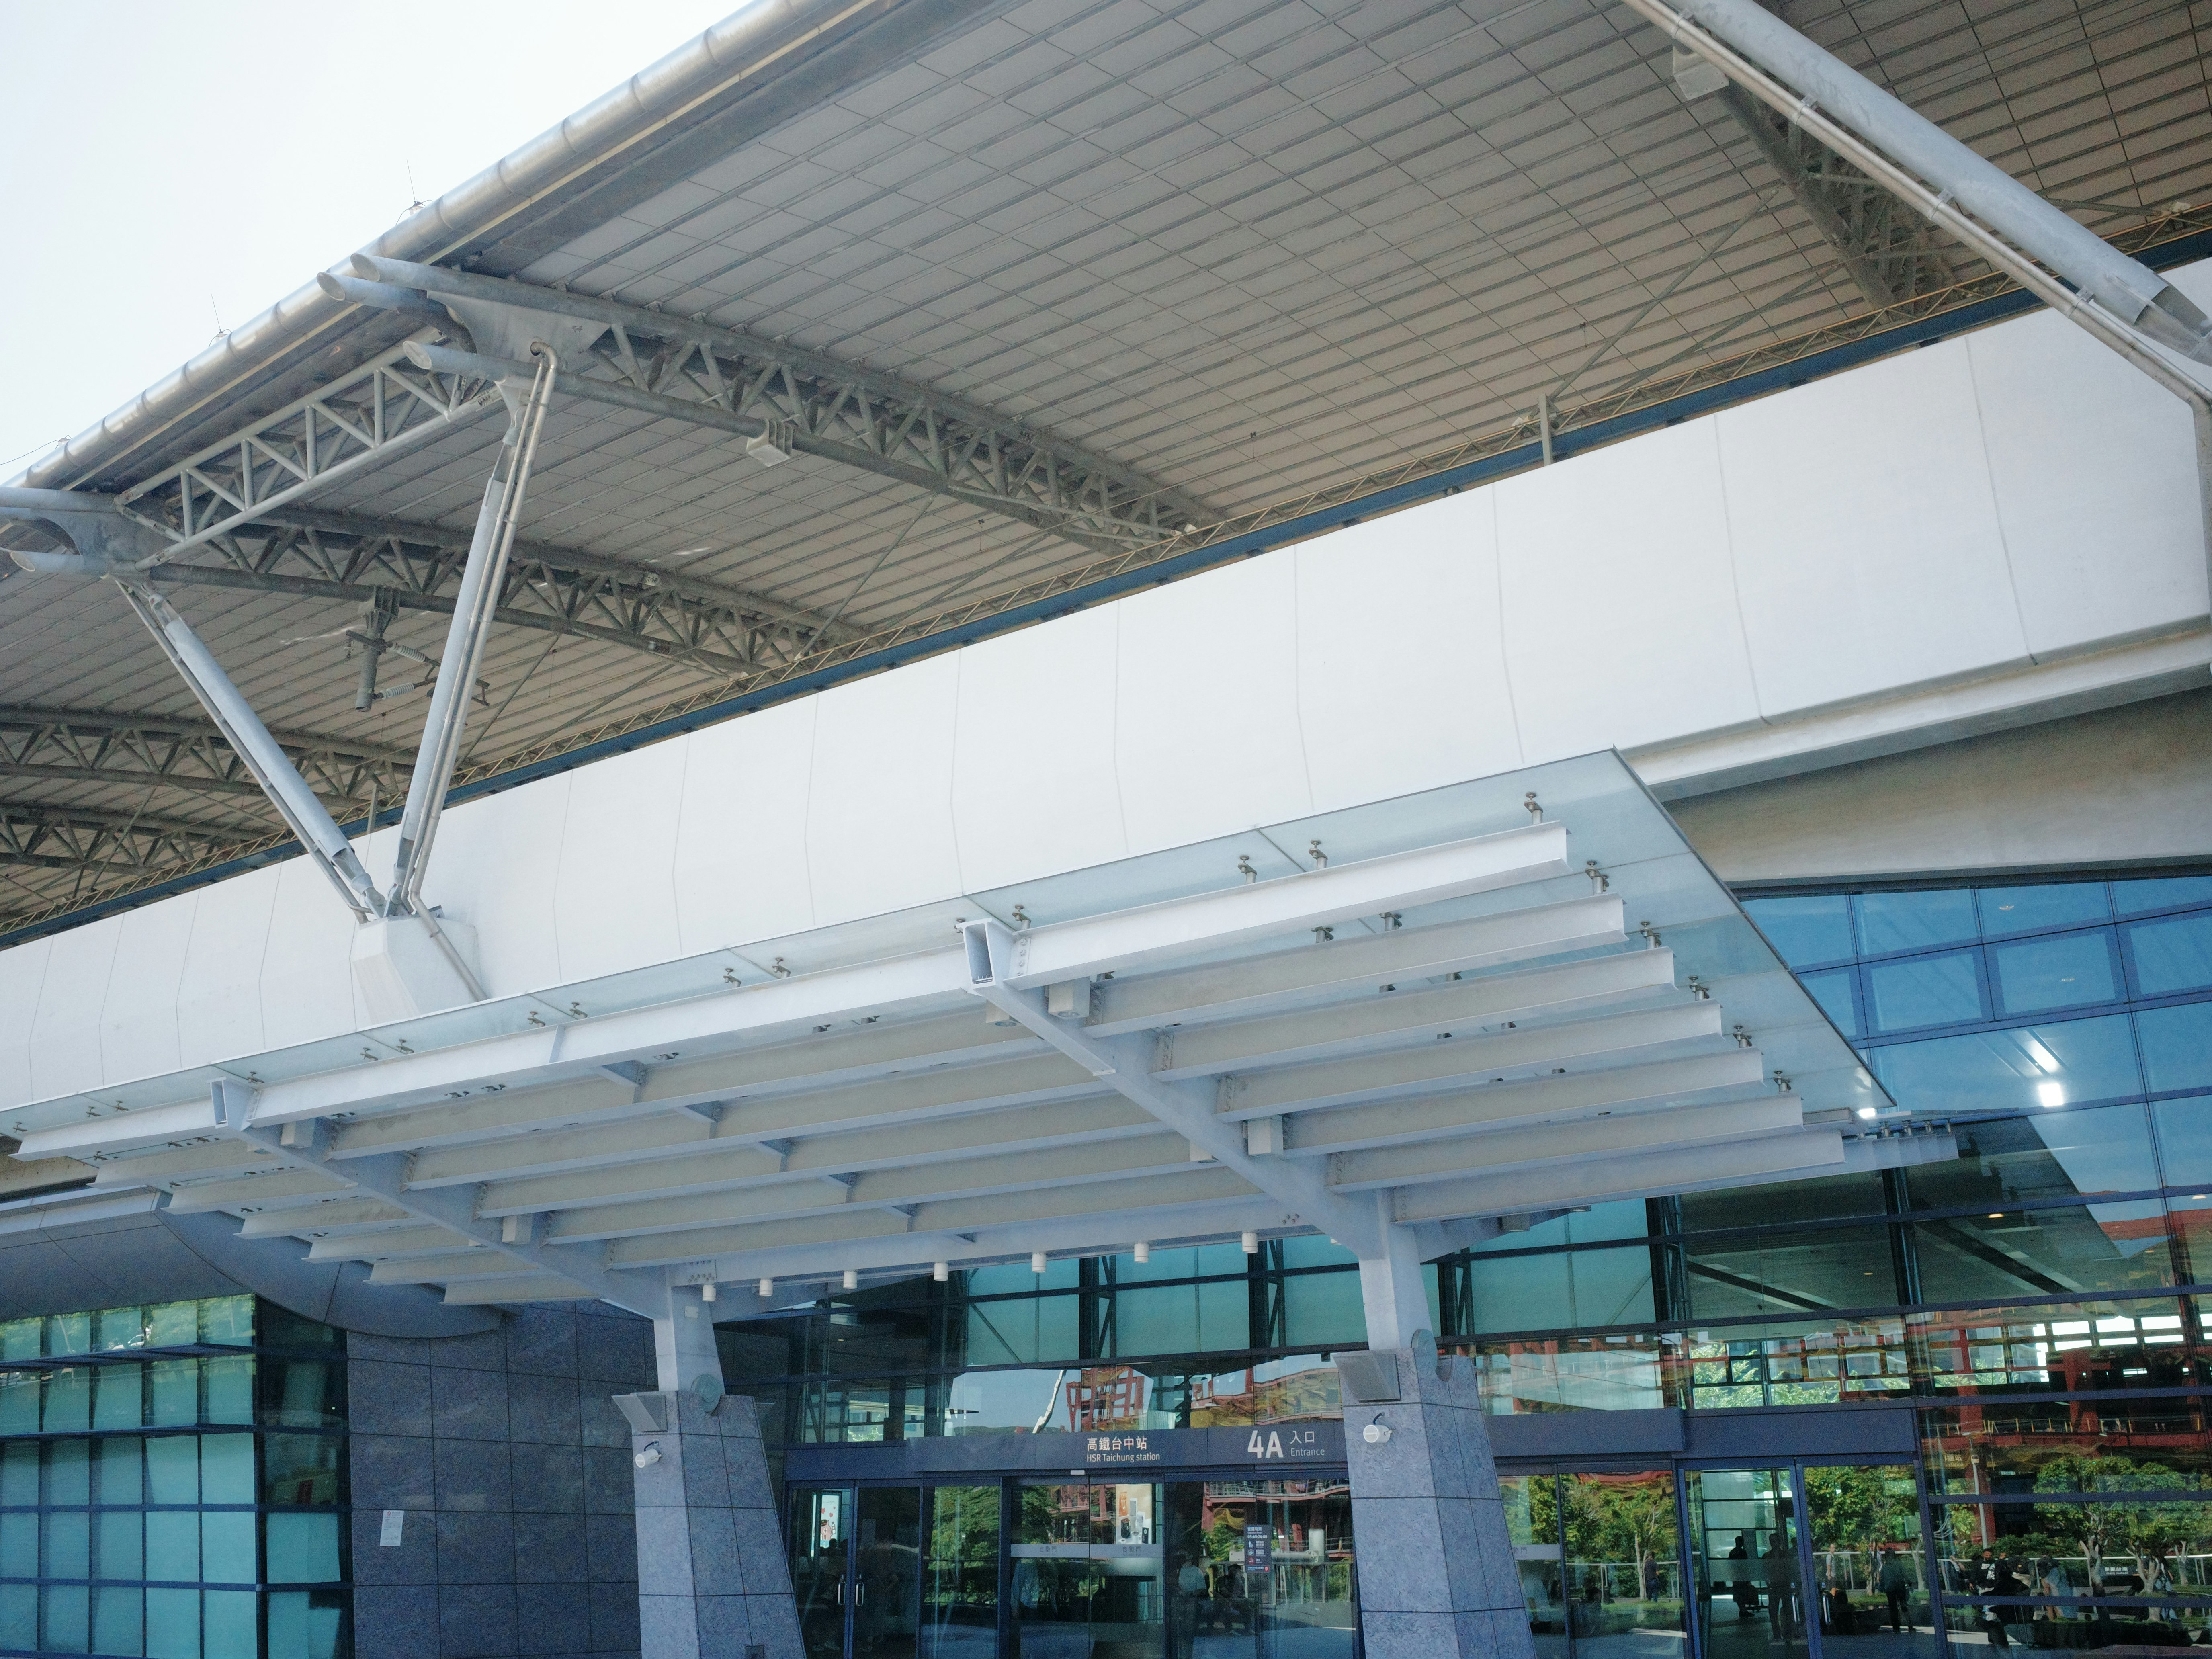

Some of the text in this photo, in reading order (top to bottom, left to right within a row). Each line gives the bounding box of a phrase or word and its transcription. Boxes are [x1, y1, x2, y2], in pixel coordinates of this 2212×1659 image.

[1086, 1435, 1147, 1452] 高鐵台中站
[1247, 1430, 1284, 1458] 4A
[1290, 1430, 1315, 1444] 入口
[1086, 1452, 1160, 1463] HSR Taichung station
[1290, 1448, 1325, 1456] Entrance
